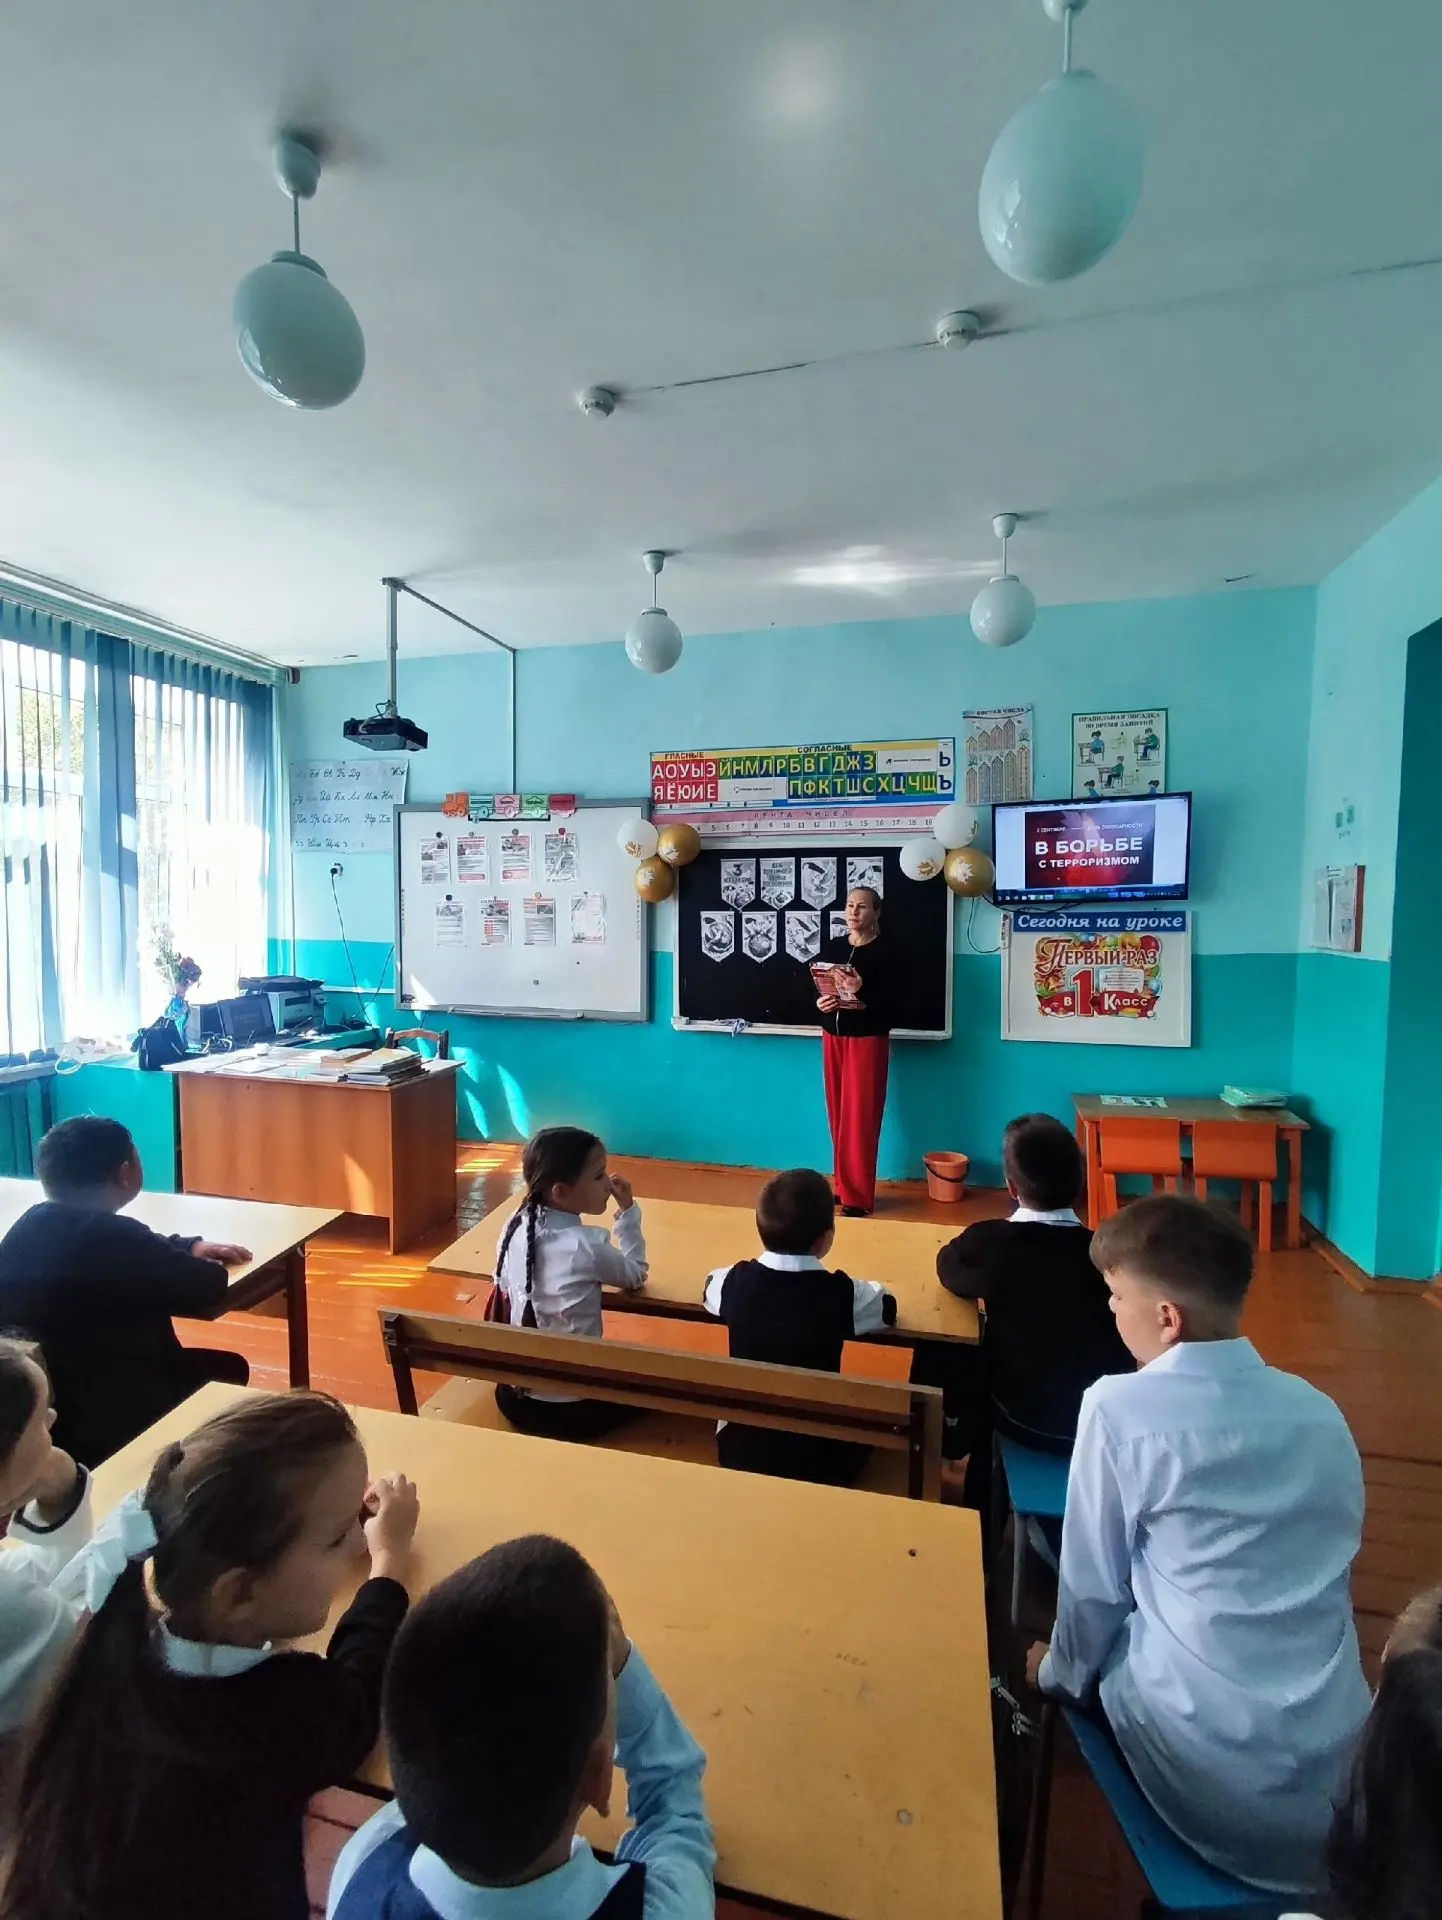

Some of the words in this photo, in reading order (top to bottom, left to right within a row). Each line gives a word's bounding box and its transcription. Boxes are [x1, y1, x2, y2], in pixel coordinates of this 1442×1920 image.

[664, 751, 705, 760] ГЛАСНЫЕ
[797, 744, 853, 753] СОГЛАСНЫЕ
[1035, 841, 1049, 855] В
[1056, 837, 1143, 854] БОРЬБЕ
[1039, 860, 1047, 868] С
[1050, 856, 1140, 868] ТЕРРОРИЗМОМ
[733, 864, 742, 876] 3
[1018, 913, 1090, 928] Сегодня
[1096, 916, 1120, 928] на
[1126, 915, 1183, 931] уроке
[1127, 949, 1158, 965] РАЗ
[1072, 968, 1094, 1017] 1
